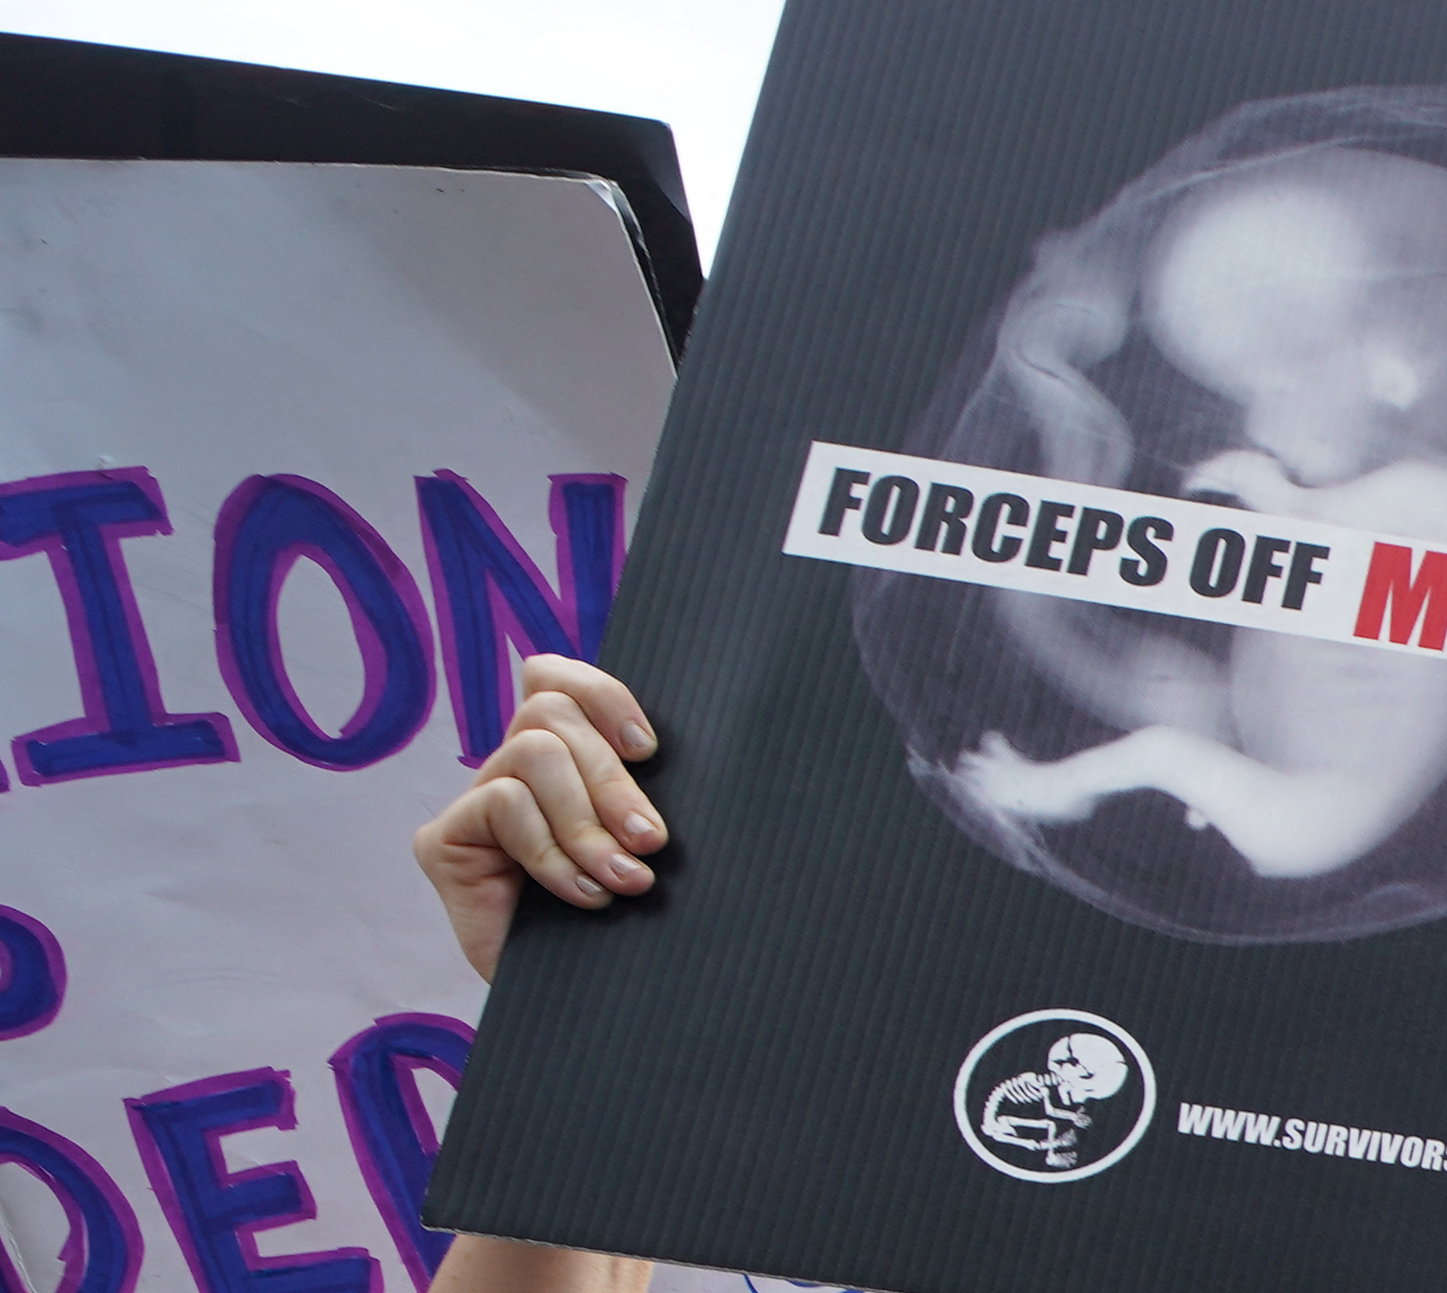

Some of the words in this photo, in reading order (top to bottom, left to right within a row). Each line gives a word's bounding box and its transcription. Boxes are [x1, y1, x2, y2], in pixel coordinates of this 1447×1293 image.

[0, 463, 628, 790] ION
[820, 468, 1175, 587] FORCEPS
[1189, 527, 1330, 612] OFF
